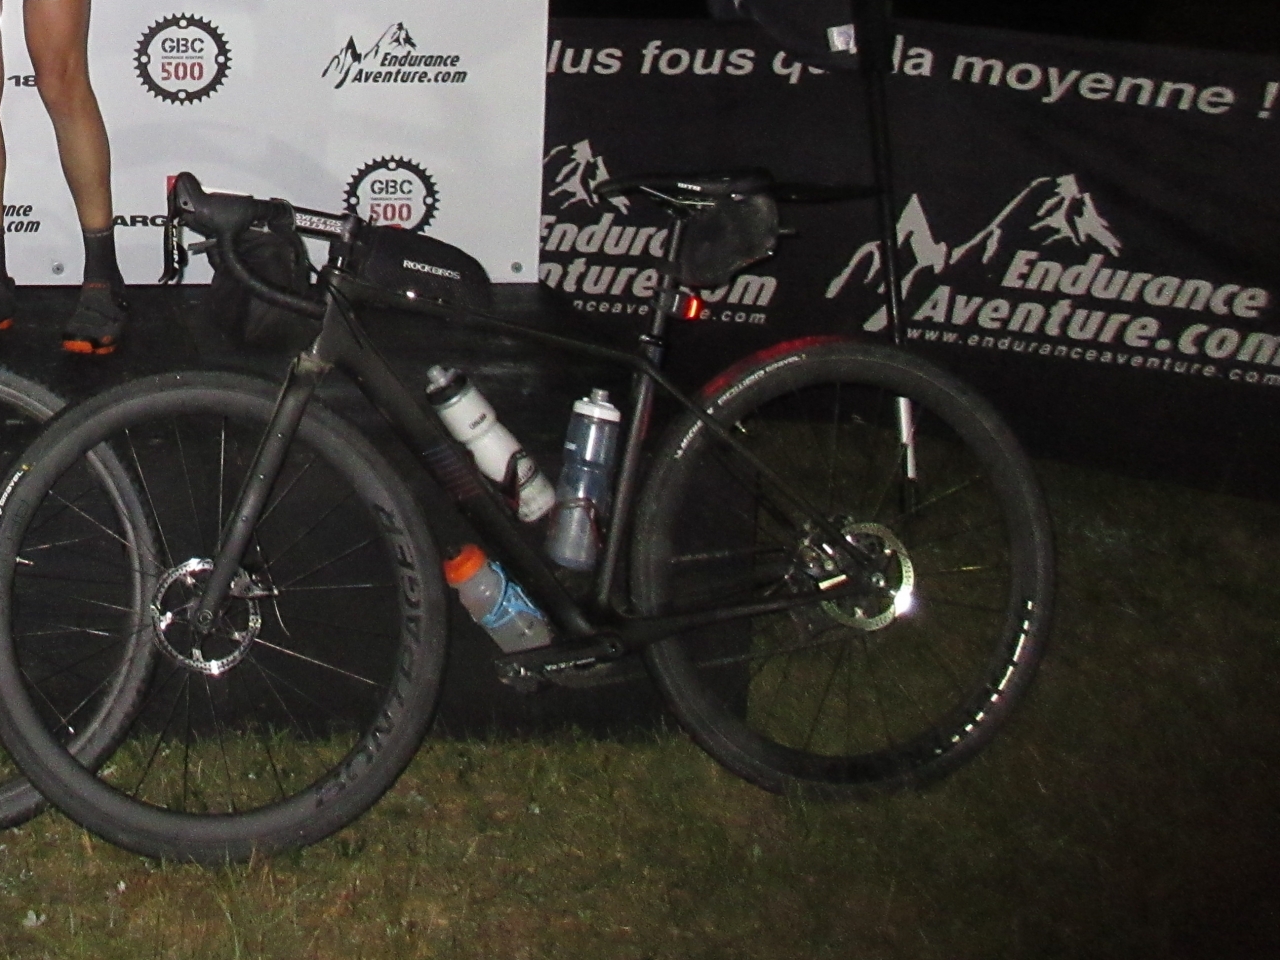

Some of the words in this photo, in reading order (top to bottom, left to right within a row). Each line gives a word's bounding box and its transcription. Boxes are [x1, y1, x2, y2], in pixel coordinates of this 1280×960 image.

[161, 37, 205, 54] GBC
[379, 51, 460, 68] Endurance
[546, 40, 623, 75] lus
[639, 40, 756, 76] fous
[161, 61, 204, 81] 500
[351, 68, 468, 84] Aventure.com
[892, 34, 935, 77] la
[951, 53, 1236, 115] moyenne
[370, 179, 413, 195] GBC
[370, 203, 412, 222] 500
[402, 259, 462, 279] ROCKBROS
[1001, 250, 1269, 318] Endurance
[913, 285, 1280, 366] Aventure.com
[906, 325, 1280, 386] www.enduranceaventure.com
